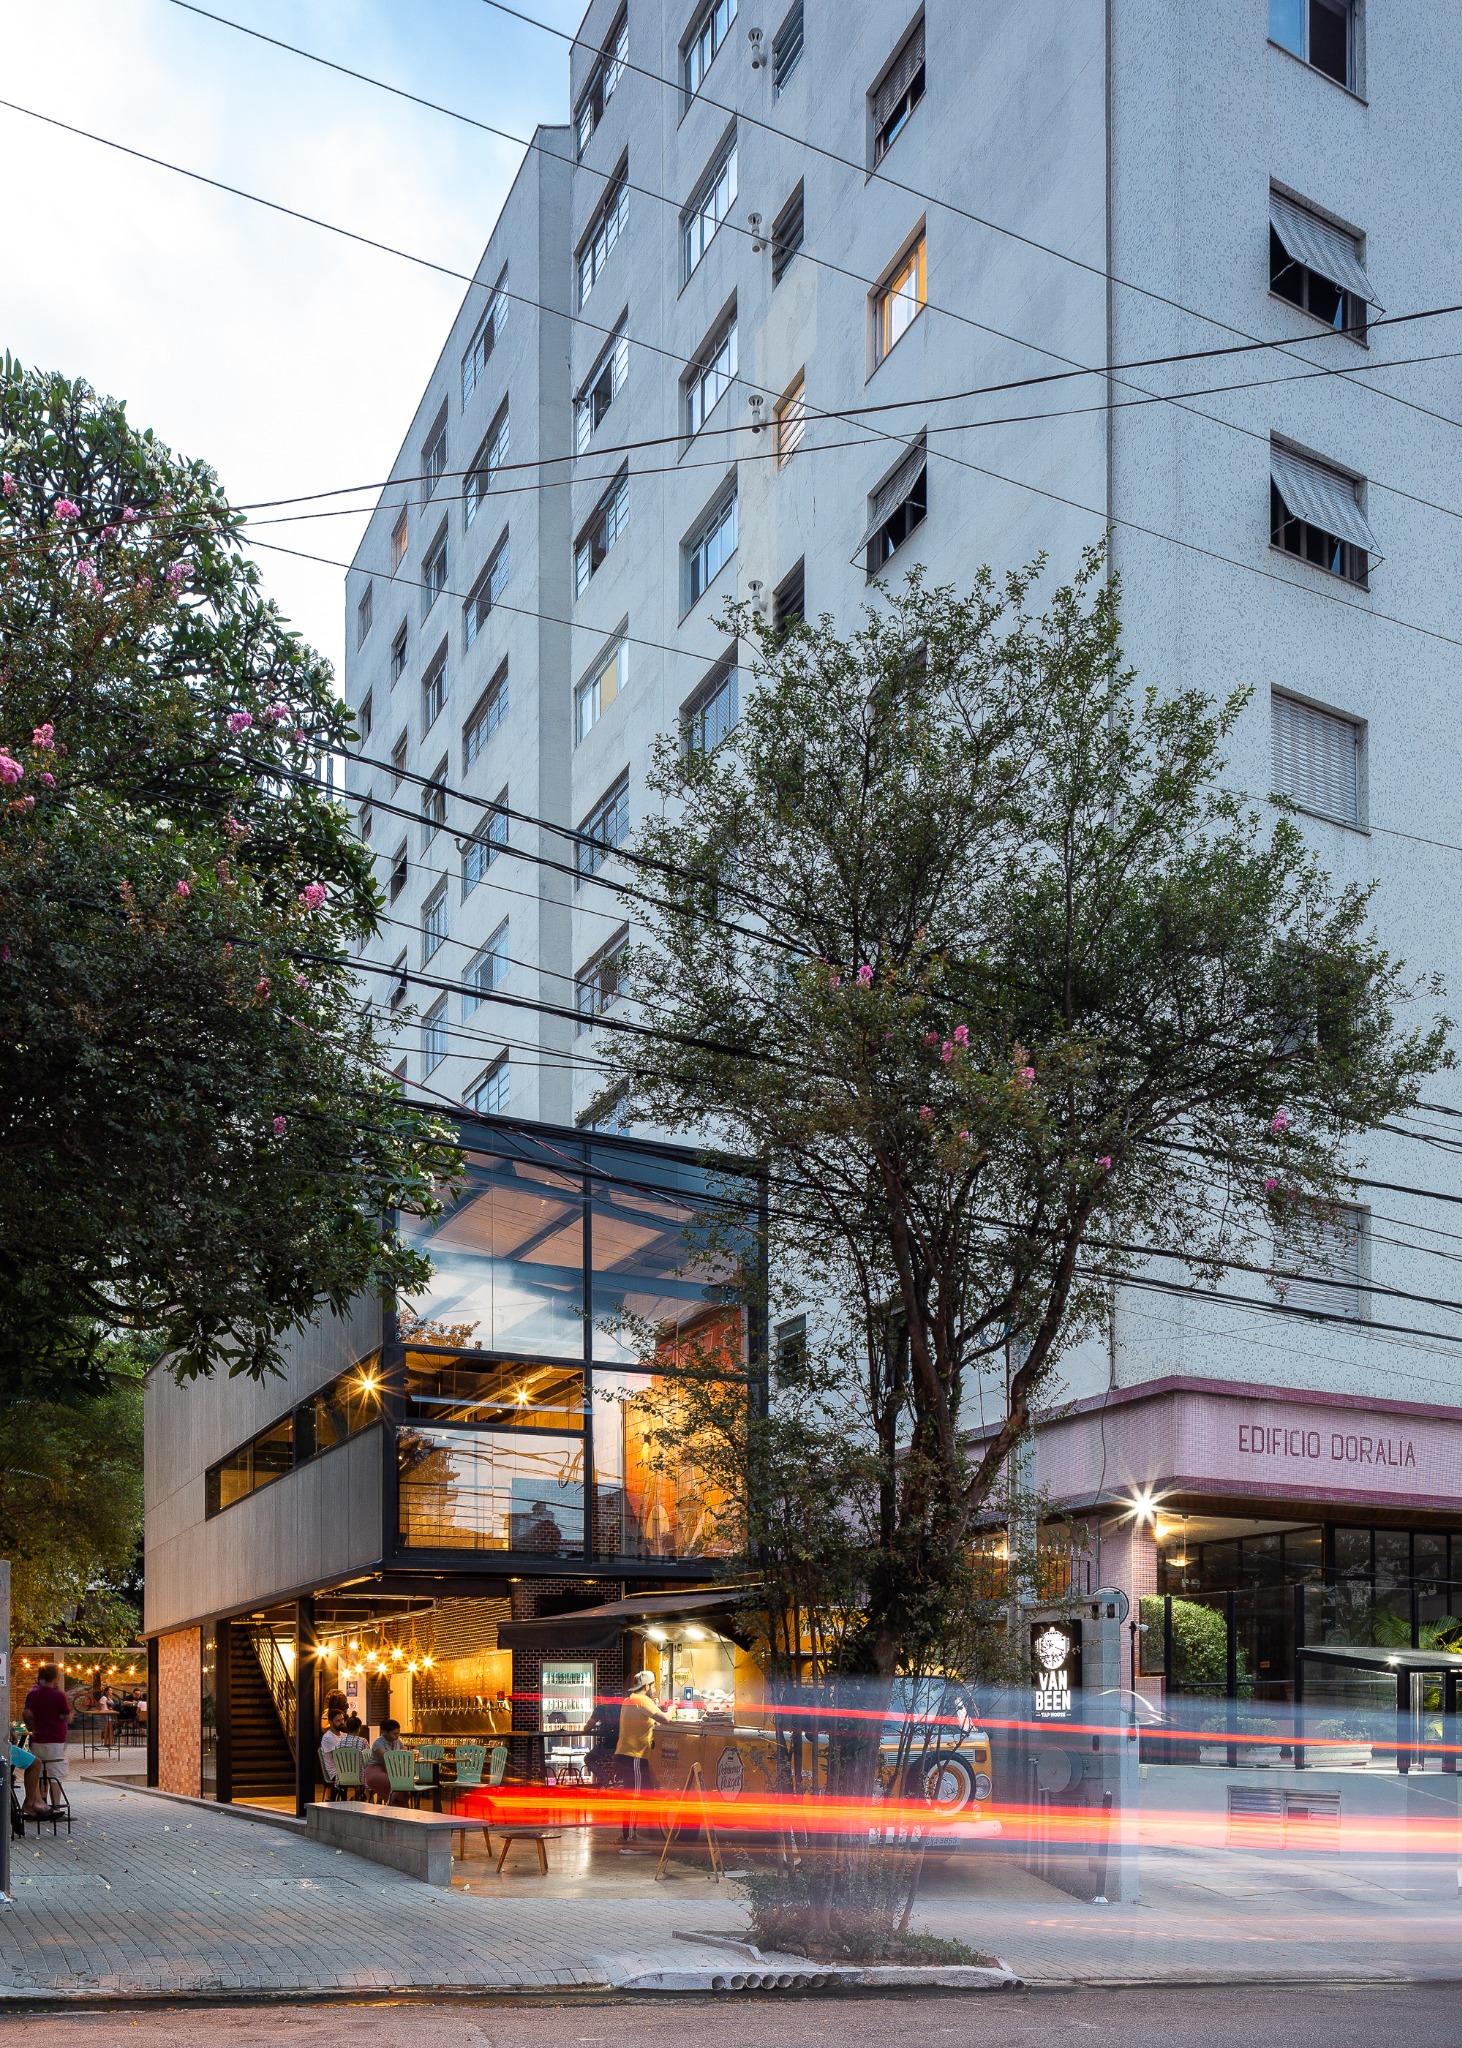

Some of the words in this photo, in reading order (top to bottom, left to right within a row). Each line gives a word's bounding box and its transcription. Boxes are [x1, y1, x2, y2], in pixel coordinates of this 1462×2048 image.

[1238, 1424, 1321, 1459] EDIFICIO
[1331, 1433, 1416, 1467] DORALÍA
[1038, 1670, 1068, 1691] VAN
[1035, 1690, 1071, 1711] BEEN
